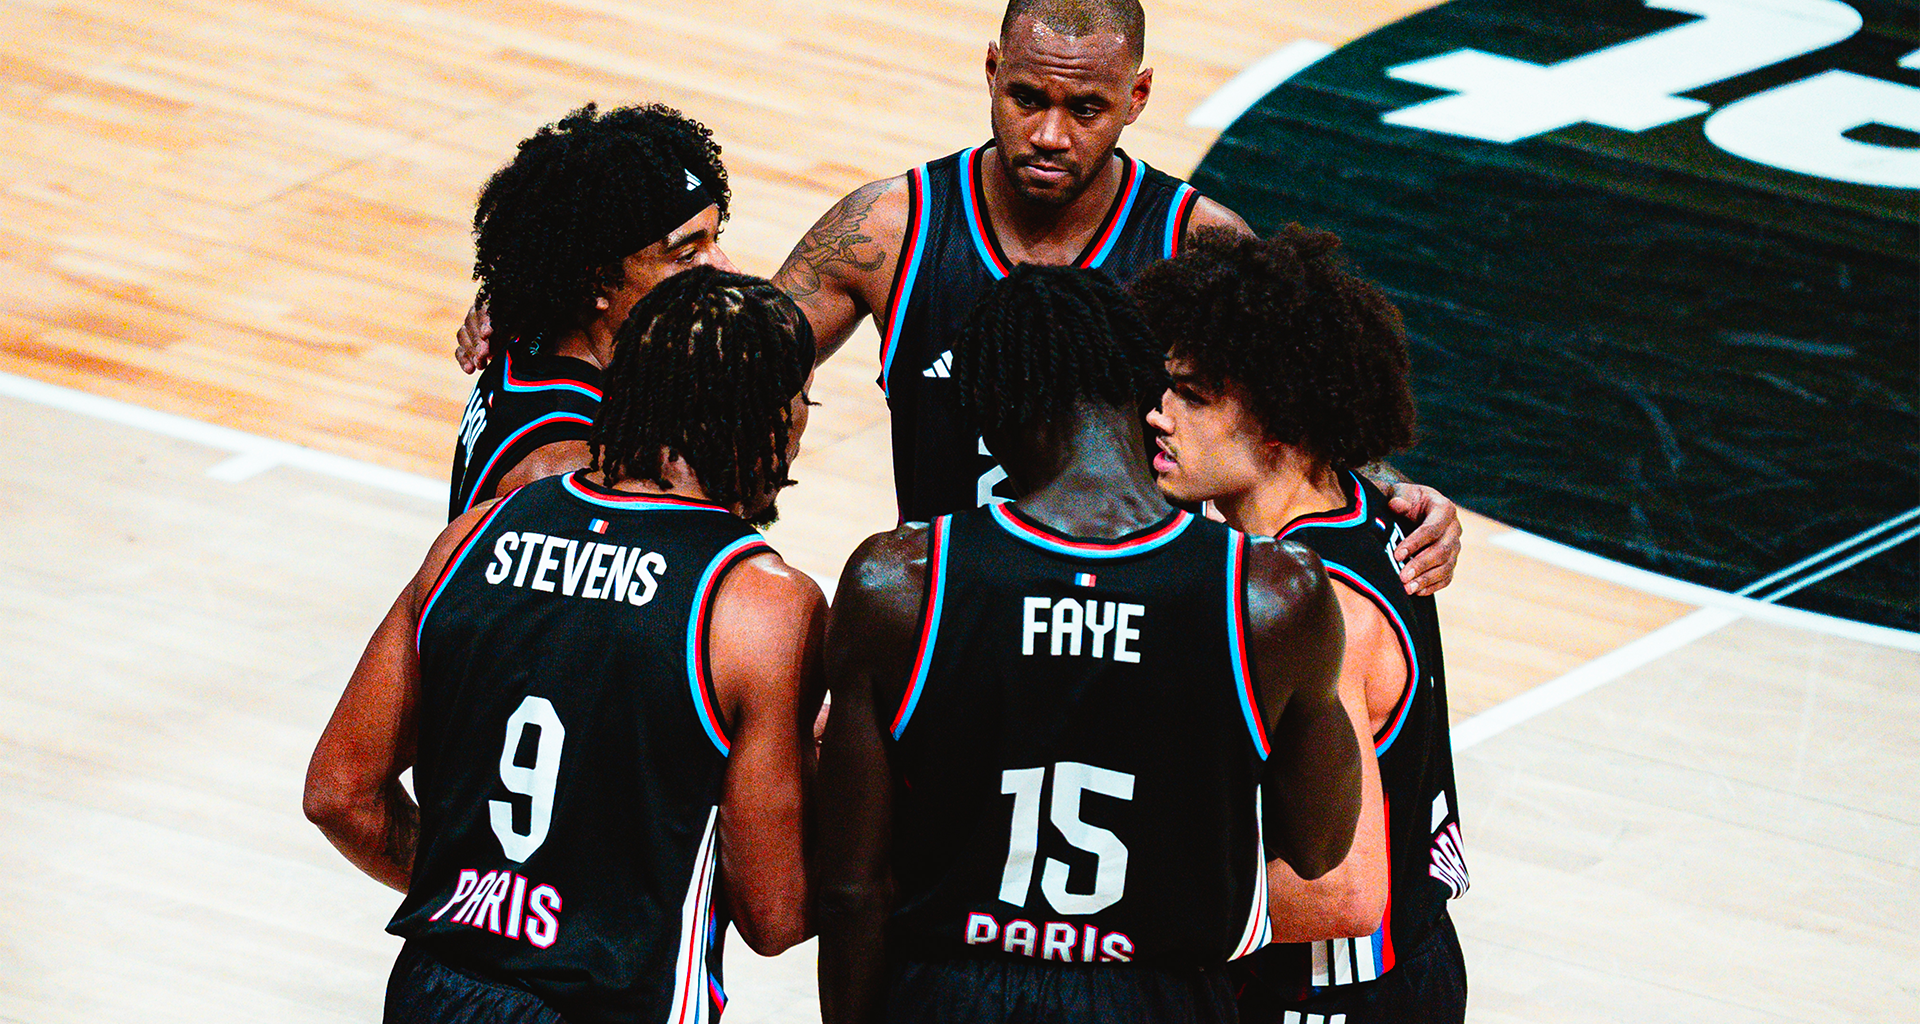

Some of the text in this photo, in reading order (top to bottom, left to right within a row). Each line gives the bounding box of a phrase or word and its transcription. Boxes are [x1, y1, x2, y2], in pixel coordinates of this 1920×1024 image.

[485, 531, 668, 607] STEVENS
[1022, 596, 1146, 664] FAYE
[488, 695, 566, 864] 9
[998, 761, 1136, 915] 15
[428, 868, 563, 949] PARIS
[964, 911, 1136, 963] PARIS
